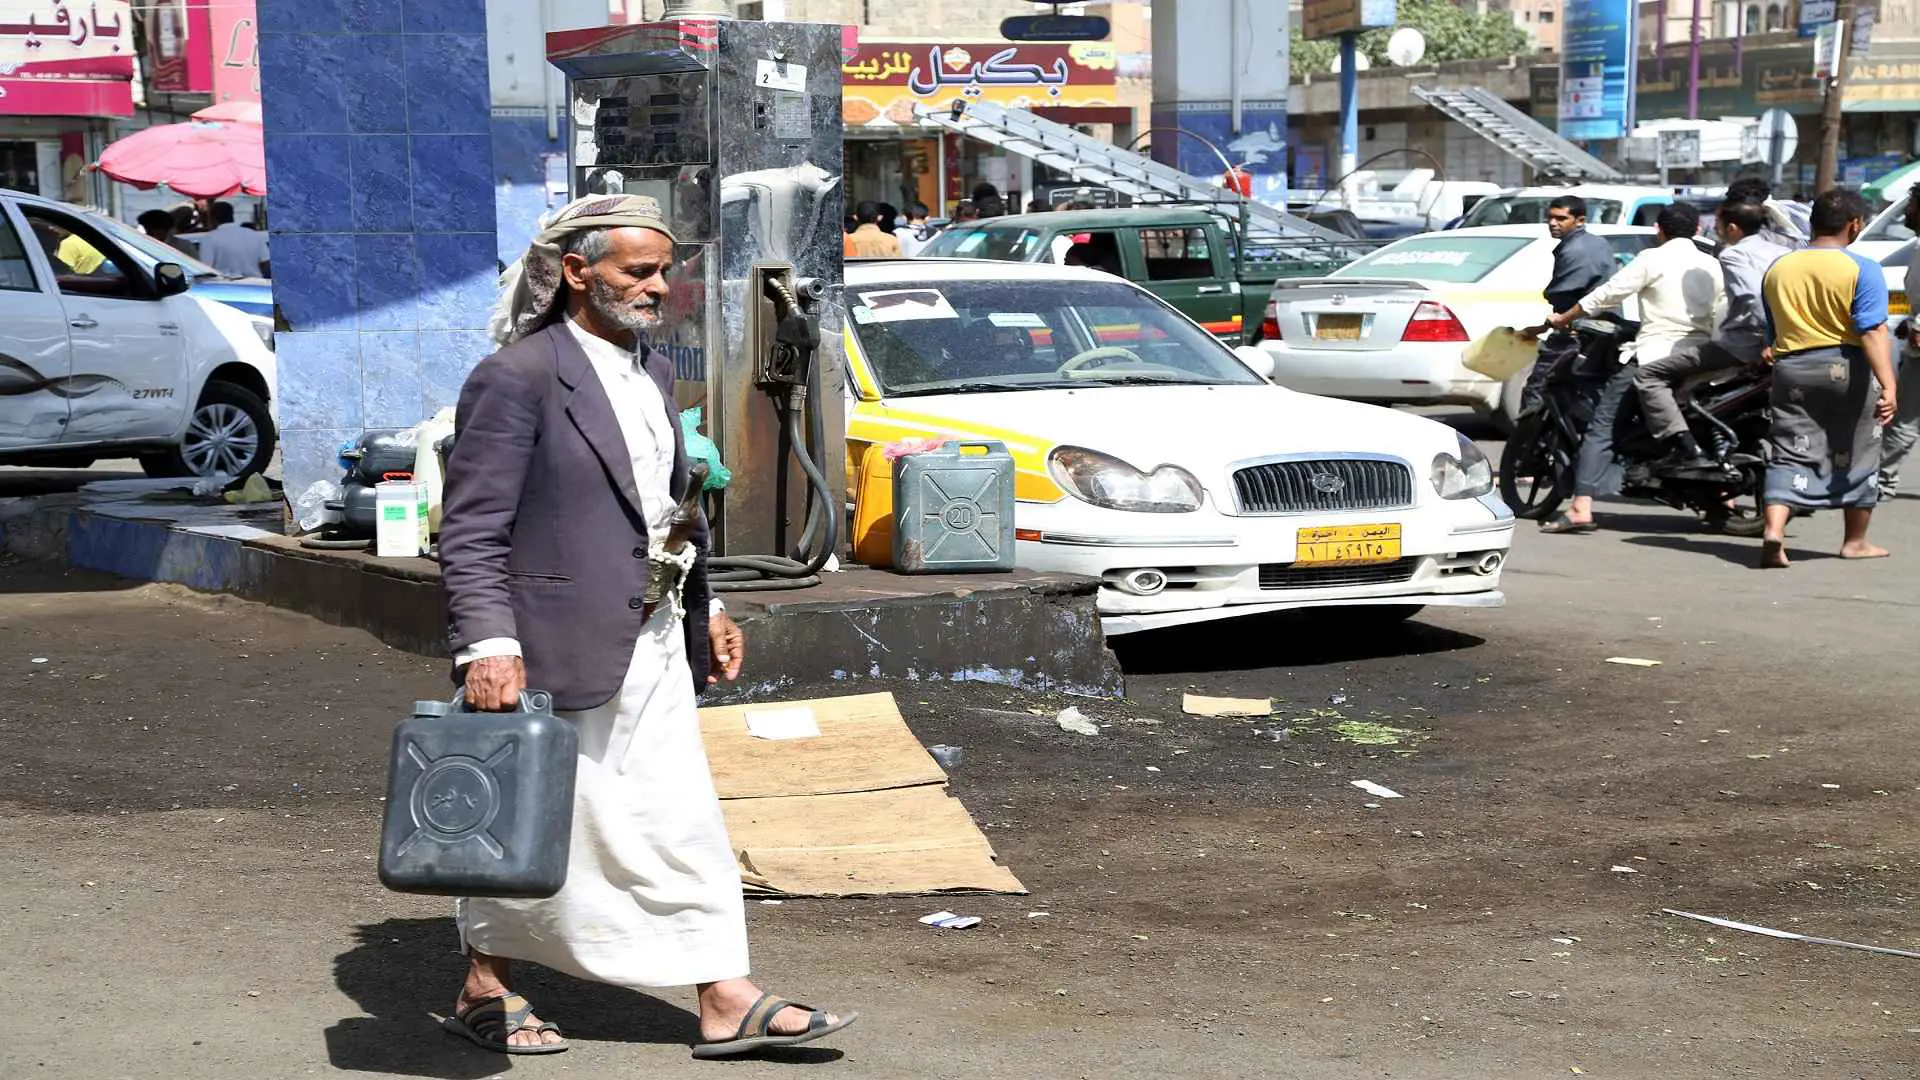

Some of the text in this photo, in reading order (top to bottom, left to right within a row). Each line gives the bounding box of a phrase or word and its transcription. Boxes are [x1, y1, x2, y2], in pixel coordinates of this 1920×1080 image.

[763, 73, 769, 83] 2
[909, 45, 1068, 96] بكيل
[949, 506, 972, 526] 20
